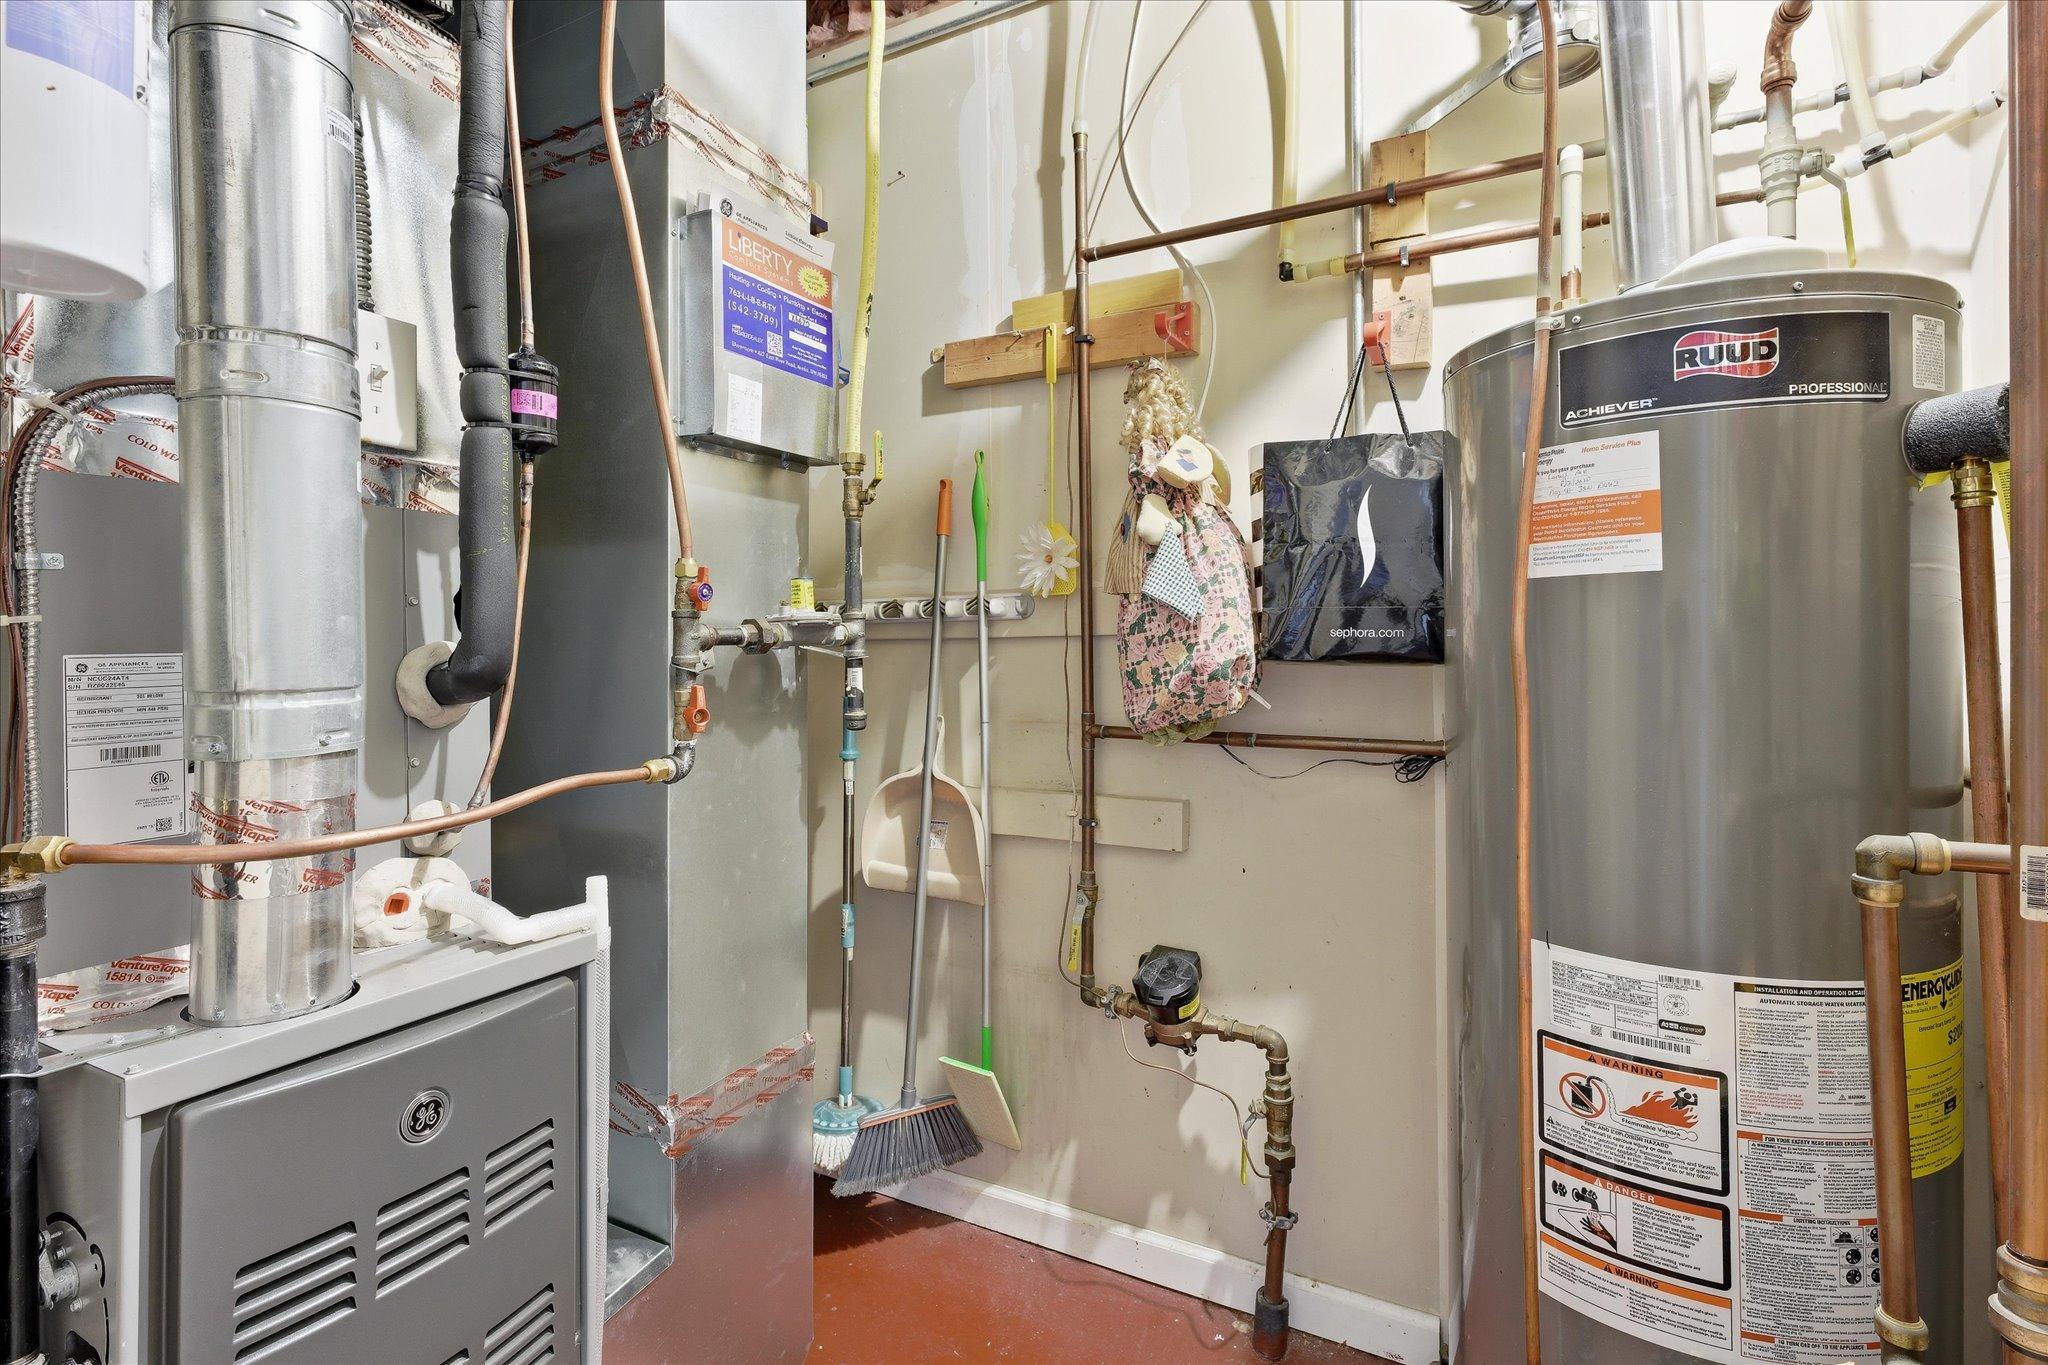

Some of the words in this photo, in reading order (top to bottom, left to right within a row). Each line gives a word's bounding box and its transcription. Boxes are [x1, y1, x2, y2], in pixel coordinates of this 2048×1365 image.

[1675, 339, 1779, 370] RUUD
[1789, 382, 1887, 395] PROFESSIONAL
[1565, 398, 1653, 421] ACHIEVER
[127, 434, 158, 452] COLD
[1626, 440, 1641, 448] Plus
[1329, 627, 1405, 640] sephora.com
[111, 959, 188, 975] VentureTape
[105, 971, 142, 983] 1581A
[1754, 986, 1798, 996] INSTALLATION
[1799, 988, 1813, 996] AND
[1813, 989, 1847, 997] OPERATION
[1760, 998, 1796, 1006] AUTOMATIC
[1601, 1057, 1665, 1080] WARNING
[1621, 1117, 1656, 1131] Flammable
[1606, 1182, 1656, 1204] DANGER
[1614, 1267, 1660, 1290] WARNING
